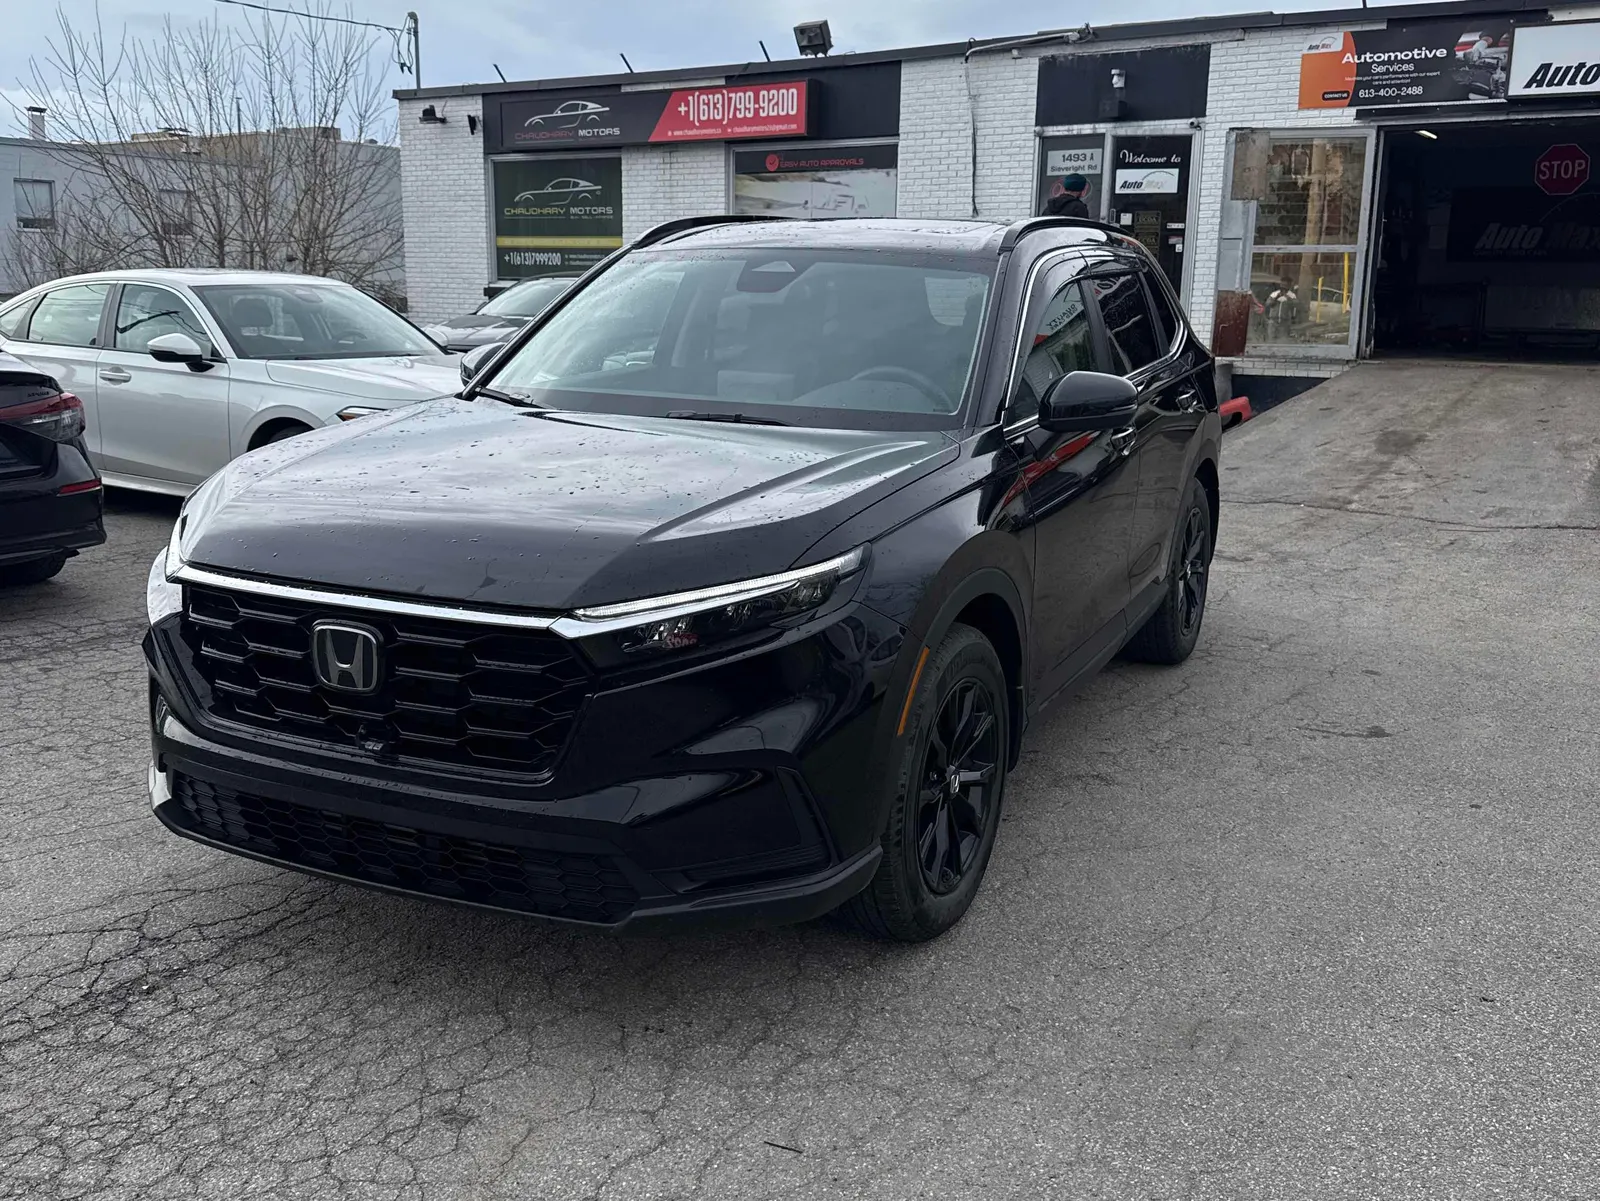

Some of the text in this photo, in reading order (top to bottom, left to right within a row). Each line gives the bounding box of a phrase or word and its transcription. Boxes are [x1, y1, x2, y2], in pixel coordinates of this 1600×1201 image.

[1342, 47, 1447, 64] Automotive
[1371, 63, 1415, 74] Services
[1523, 62, 1600, 89] Auto
[1359, 86, 1423, 98] 613-400-2488
[678, 88, 797, 126] +1(613)799-9200
[515, 127, 620, 140] CHAUDHARY MOTORS
[820, 158, 864, 166] APPROVALS
[1062, 153, 1087, 163] 1493
[1120, 149, 1181, 163] Welcome to
[1539, 160, 1586, 180] STOP
[1119, 180, 1144, 190] Auto
[504, 206, 613, 215] CHAUDHARY MOTORS
[1474, 222, 1543, 249] Auto
[504, 252, 561, 266] +1(613)7999200
